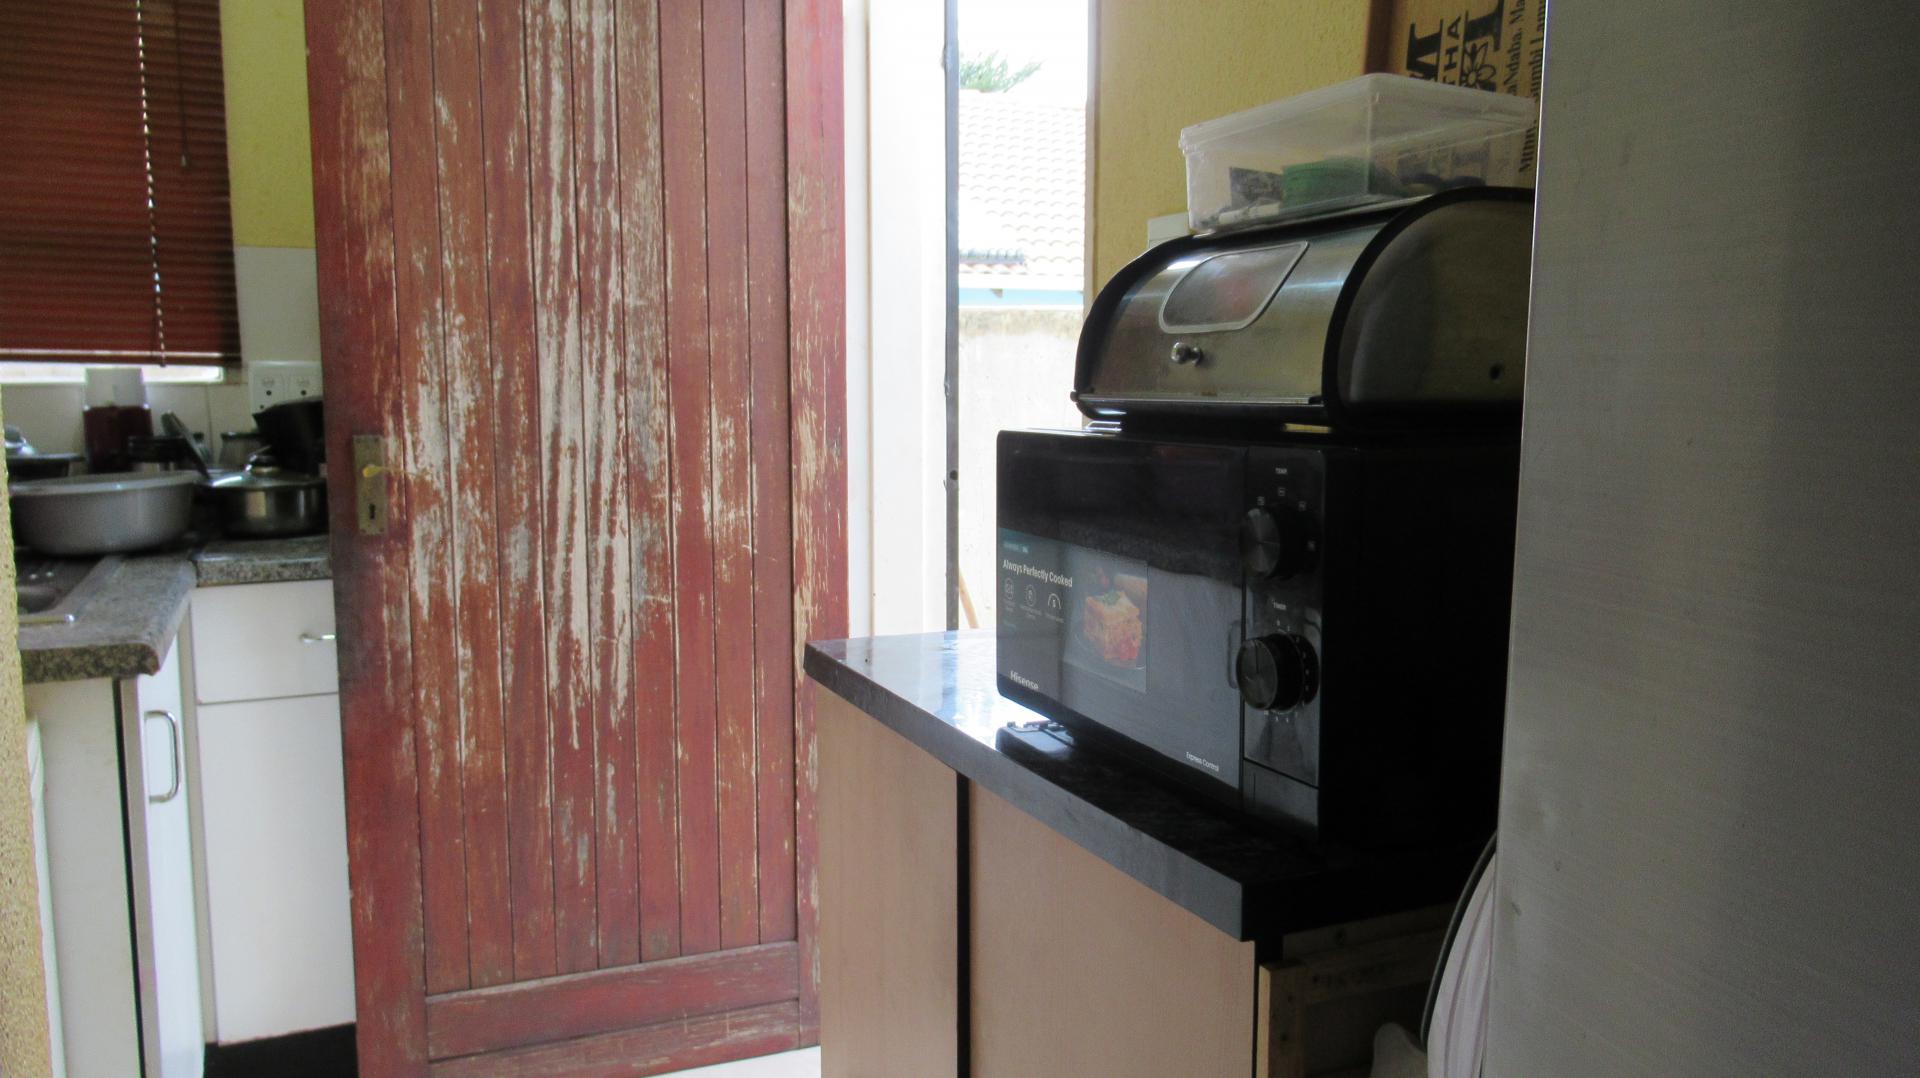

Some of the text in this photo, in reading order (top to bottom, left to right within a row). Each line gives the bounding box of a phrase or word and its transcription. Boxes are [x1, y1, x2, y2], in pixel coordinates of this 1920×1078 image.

[1002, 560, 1072, 588] Always Perfectly Cooked
[1010, 669, 1039, 690] Hisense
